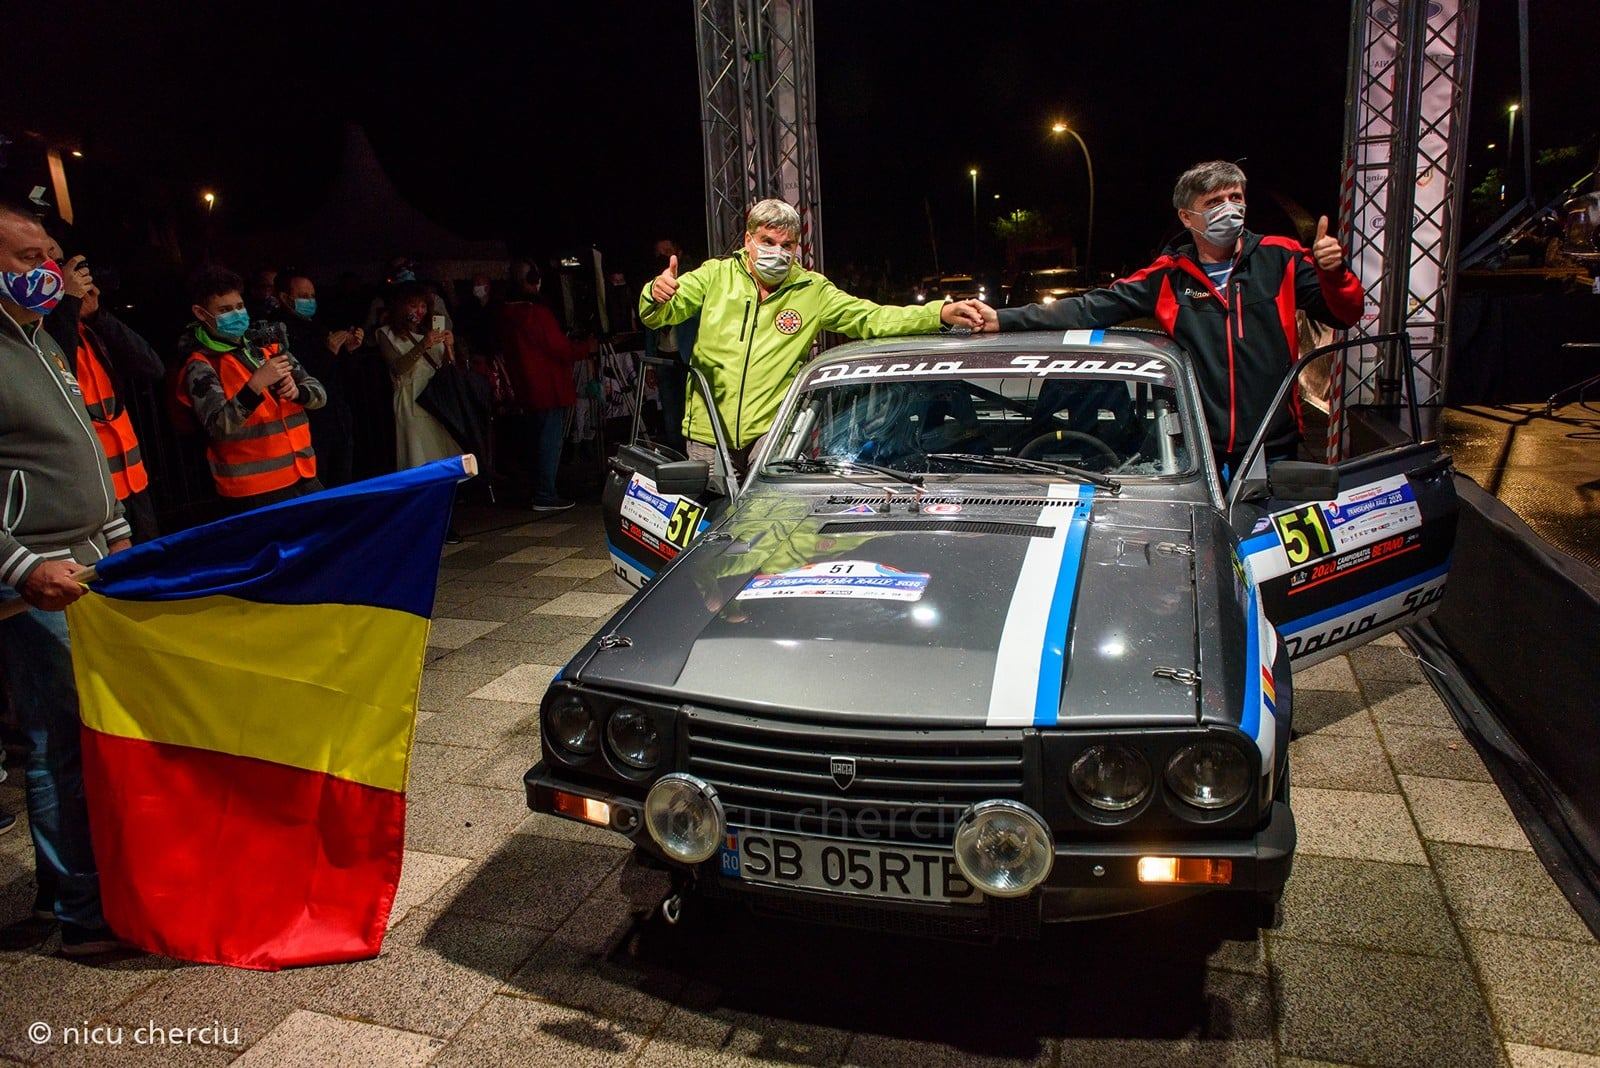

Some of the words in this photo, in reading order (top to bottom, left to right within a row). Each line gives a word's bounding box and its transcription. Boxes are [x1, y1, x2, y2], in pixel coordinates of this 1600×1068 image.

[809, 360, 963, 385] Dacia
[1010, 355, 1166, 378] Sport
[667, 500, 700, 548] 51
[1277, 506, 1331, 563] 51
[828, 564, 855, 574] 51
[1311, 560, 1337, 580] 2020
[1372, 536, 1404, 558] BETANO
[722, 852, 739, 871] RO
[743, 836, 802, 881] SB
